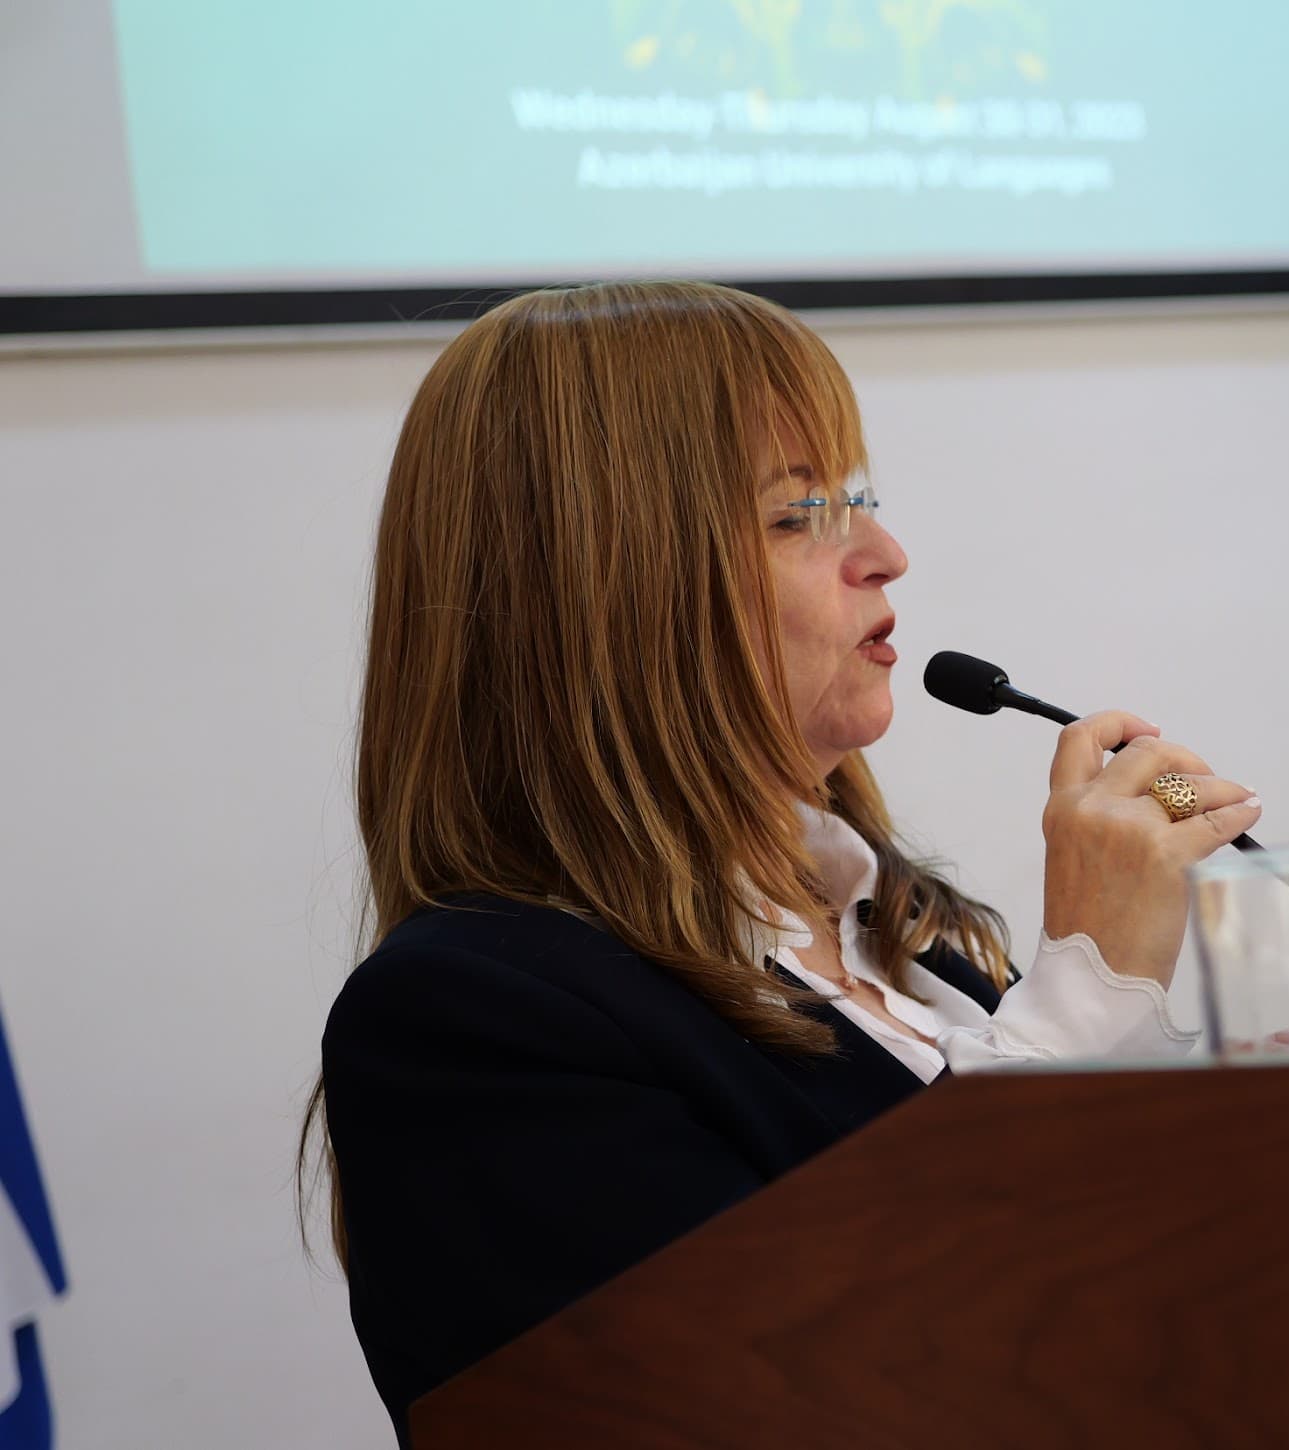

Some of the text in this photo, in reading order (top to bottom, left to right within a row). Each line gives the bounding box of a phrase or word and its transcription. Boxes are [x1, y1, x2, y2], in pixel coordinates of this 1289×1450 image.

[577, 147, 754, 195] Azerbaijan
[759, 149, 917, 193] University
[921, 149, 956, 188] of
